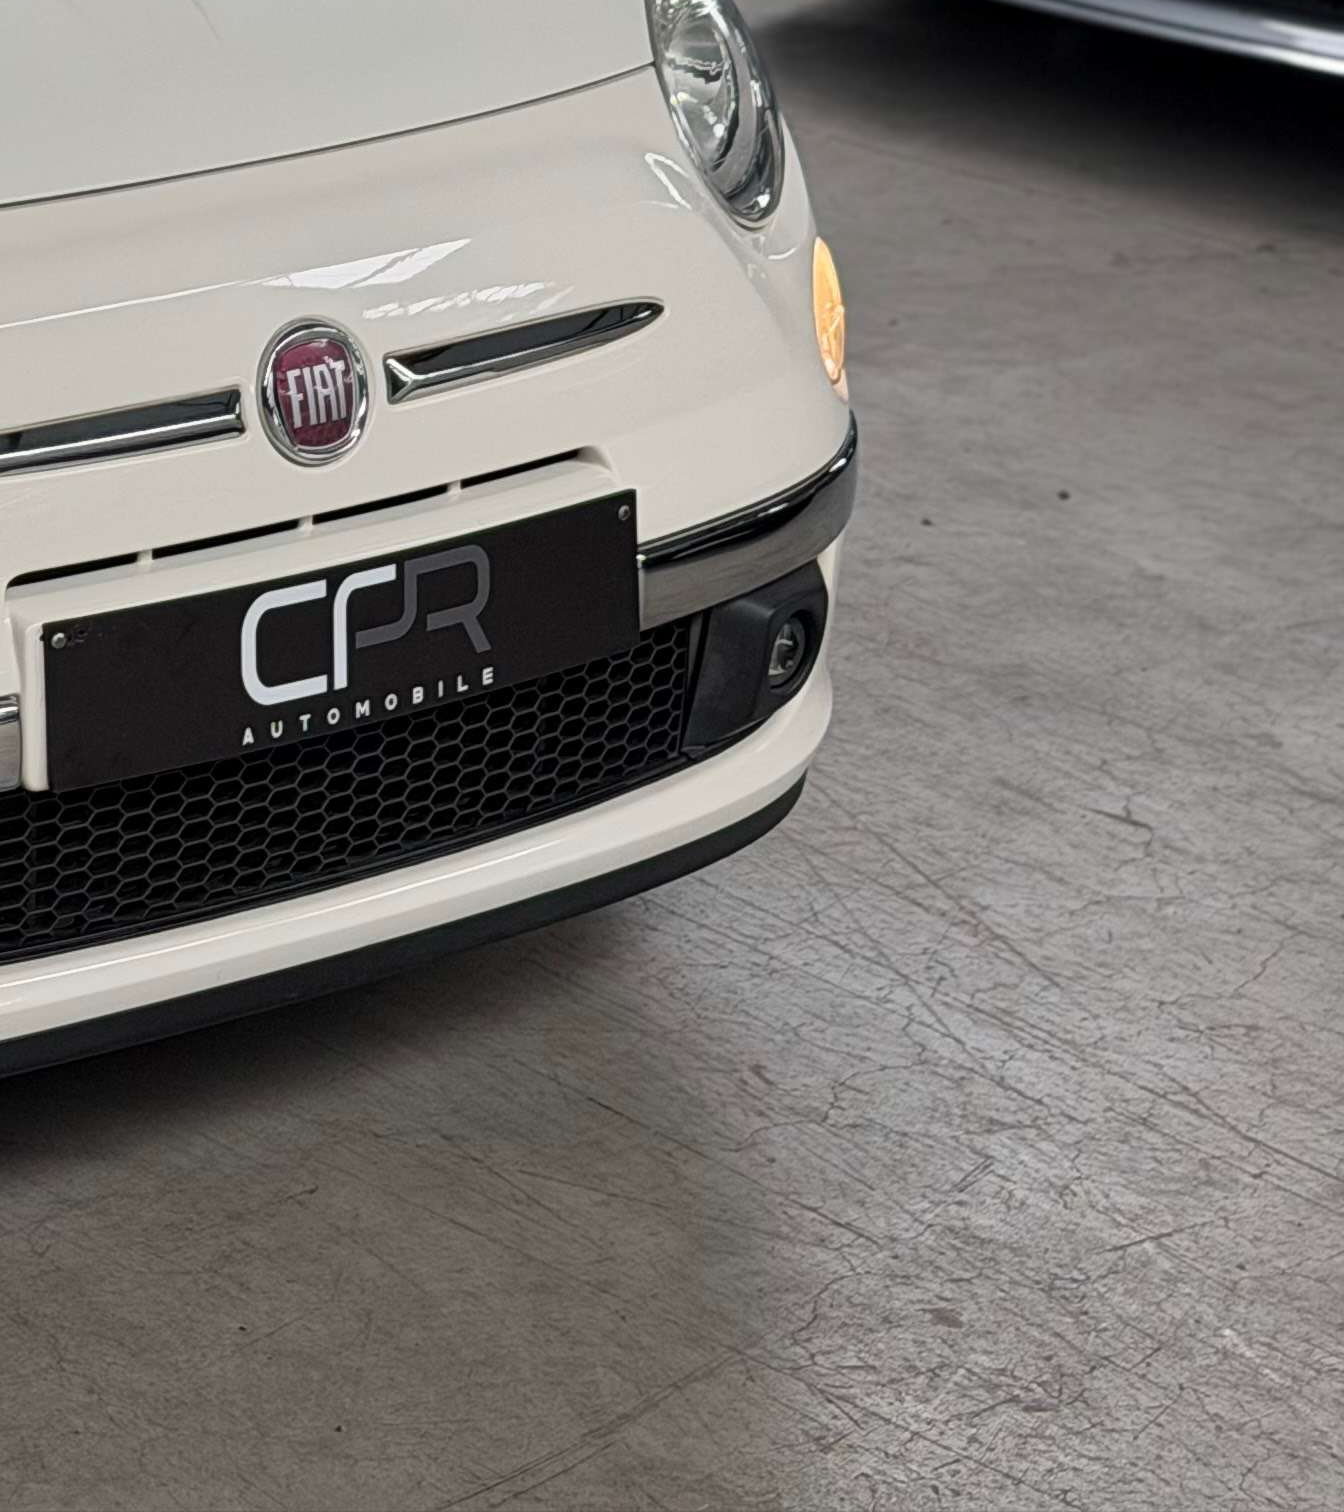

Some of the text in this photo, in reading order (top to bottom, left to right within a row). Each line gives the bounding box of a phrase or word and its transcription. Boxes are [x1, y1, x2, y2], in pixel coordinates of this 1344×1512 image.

[286, 357, 347, 429] FIAT
[241, 544, 492, 706] CPR
[242, 666, 494, 746] AUTOMOBILE
